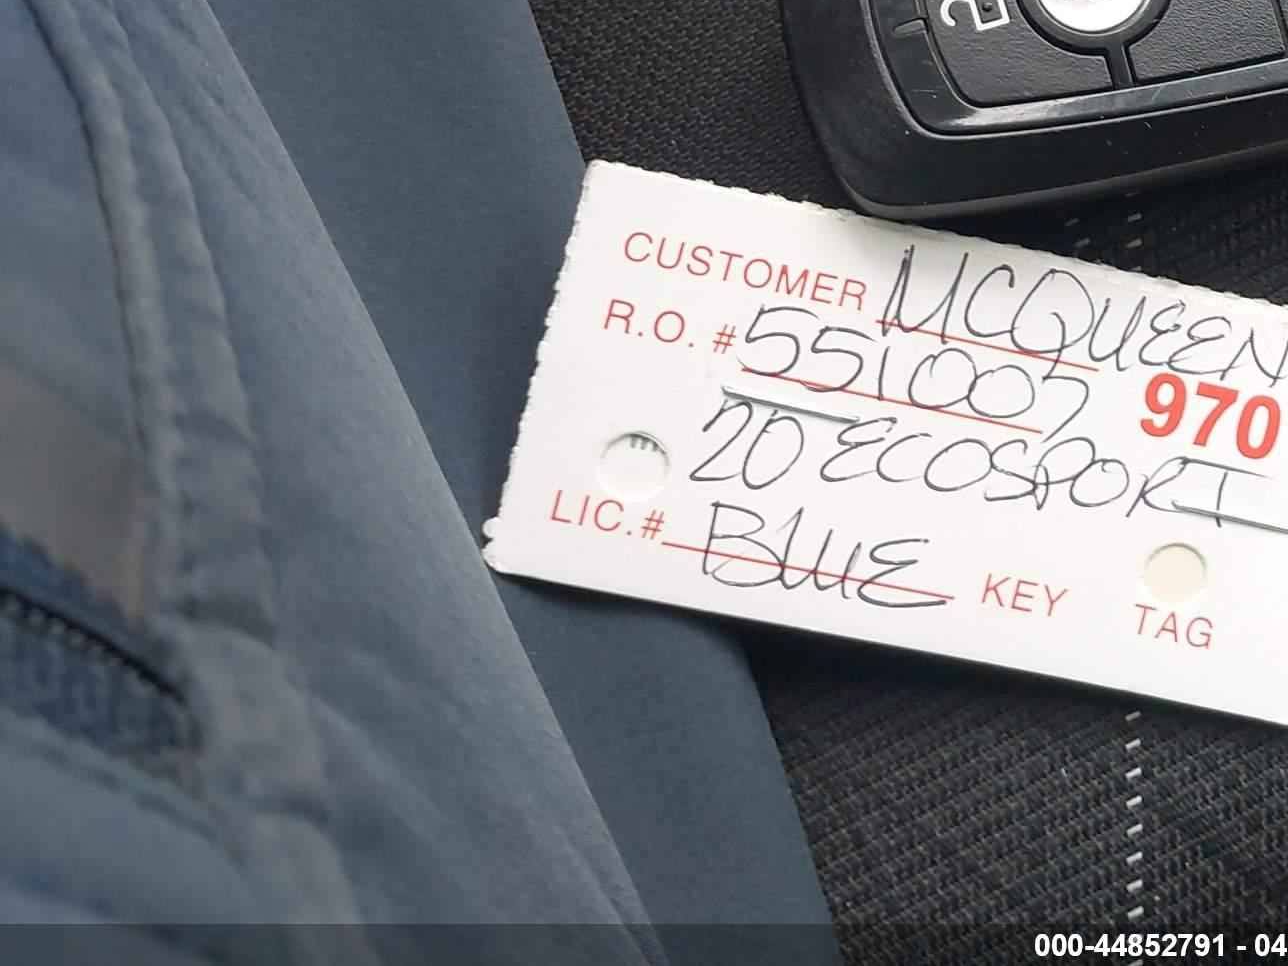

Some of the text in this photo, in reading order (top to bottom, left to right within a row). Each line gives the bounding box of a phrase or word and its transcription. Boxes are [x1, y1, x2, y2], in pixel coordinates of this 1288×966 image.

[623, 231, 867, 311] CUSTOMER
[603, 298, 737, 354] R.O. #
[690, 398, 804, 490] 20
[1139, 371, 1281, 460] 970
[549, 489, 664, 540] LIC.#
[981, 573, 1214, 650] KEY TAG
